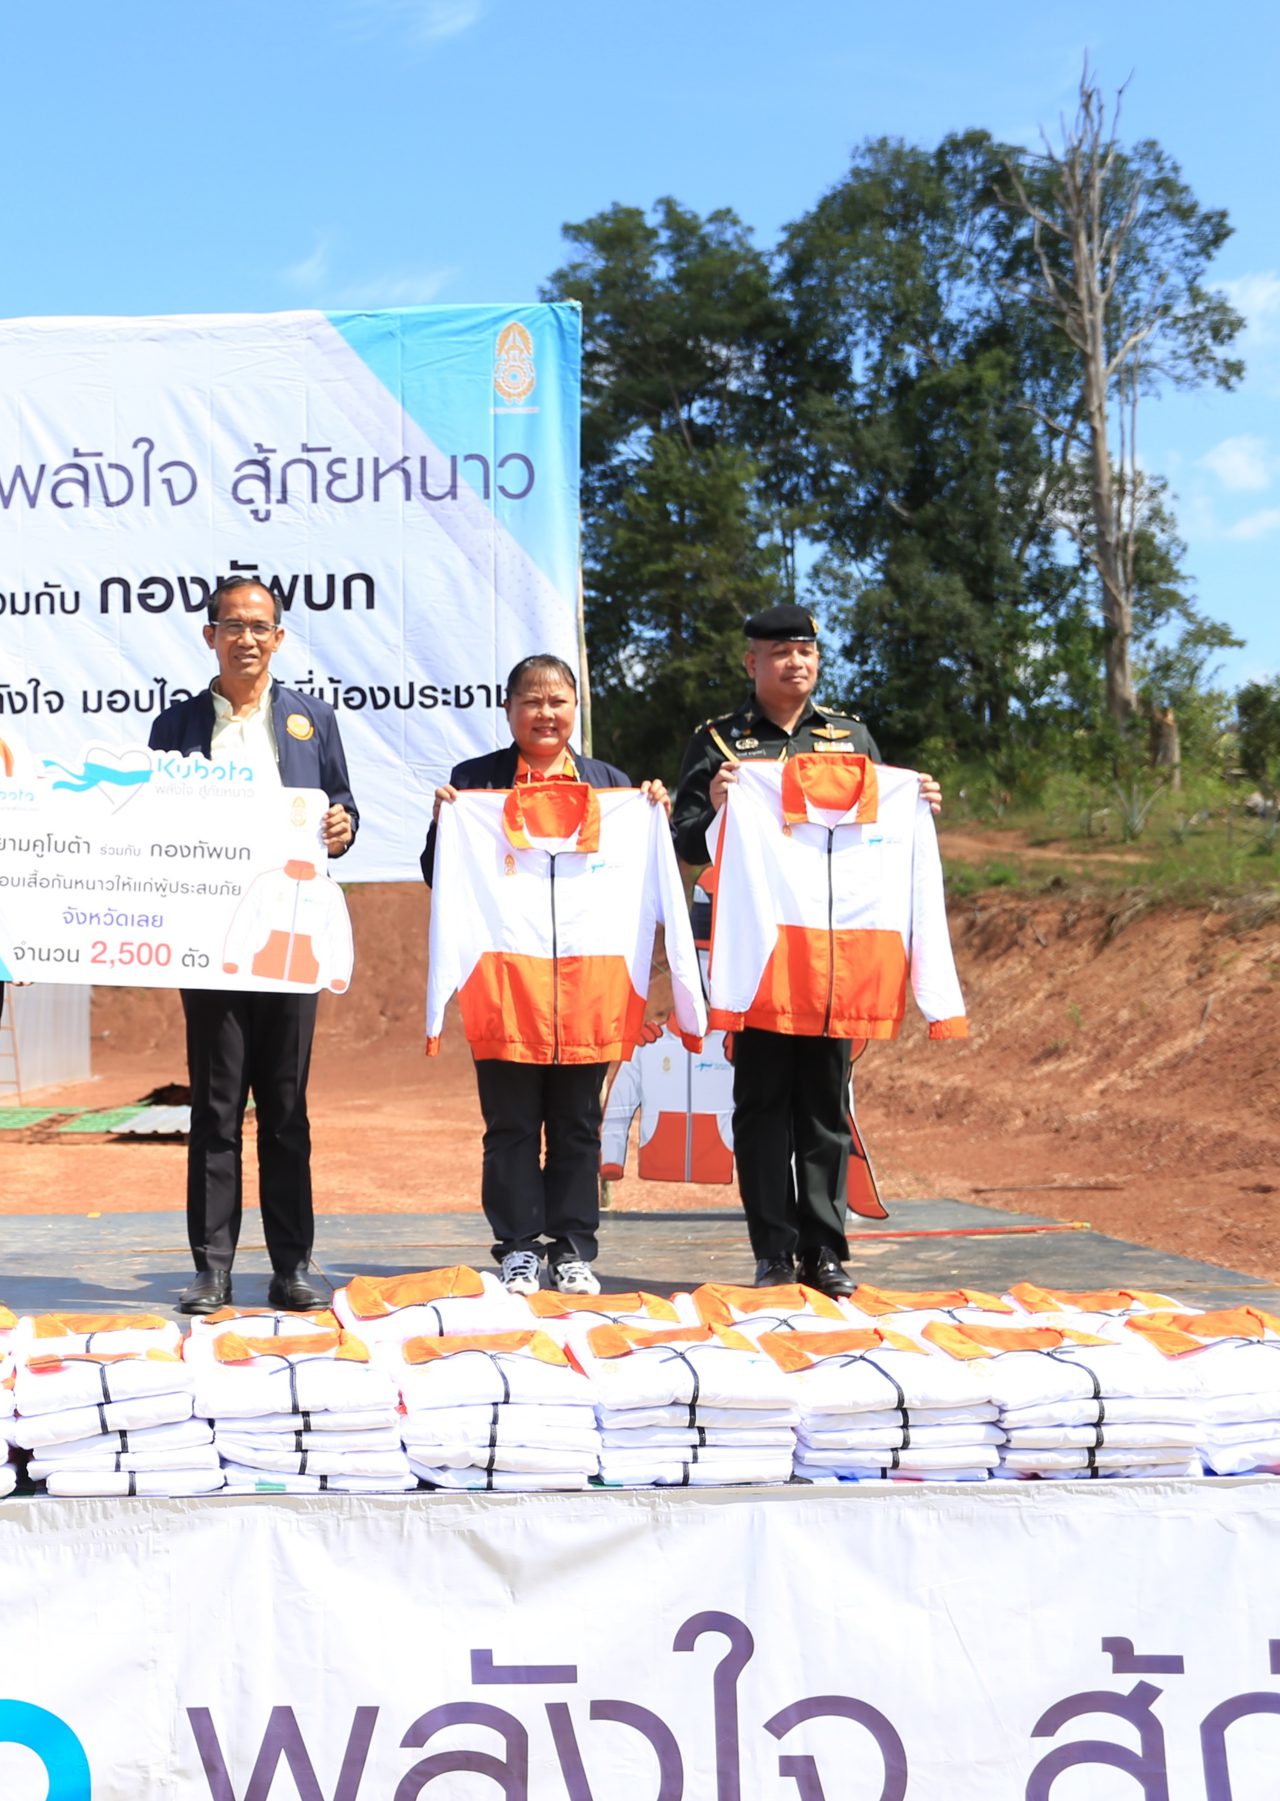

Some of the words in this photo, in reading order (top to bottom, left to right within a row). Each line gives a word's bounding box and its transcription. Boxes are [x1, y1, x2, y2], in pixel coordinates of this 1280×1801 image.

[231, 442, 536, 522] สู้ภัยหนาว
[99, 559, 376, 614] กองัพบก
[156, 757, 254, 782] Kubota
[99, 843, 142, 857] ร่วมกับ
[150, 840, 252, 861] กองทัพบก
[62, 906, 164, 928] จังหวัดเลย
[12, 940, 80, 963] จำนวน
[90, 940, 173, 968] 2,500
[181, 947, 210, 969] ตัว
